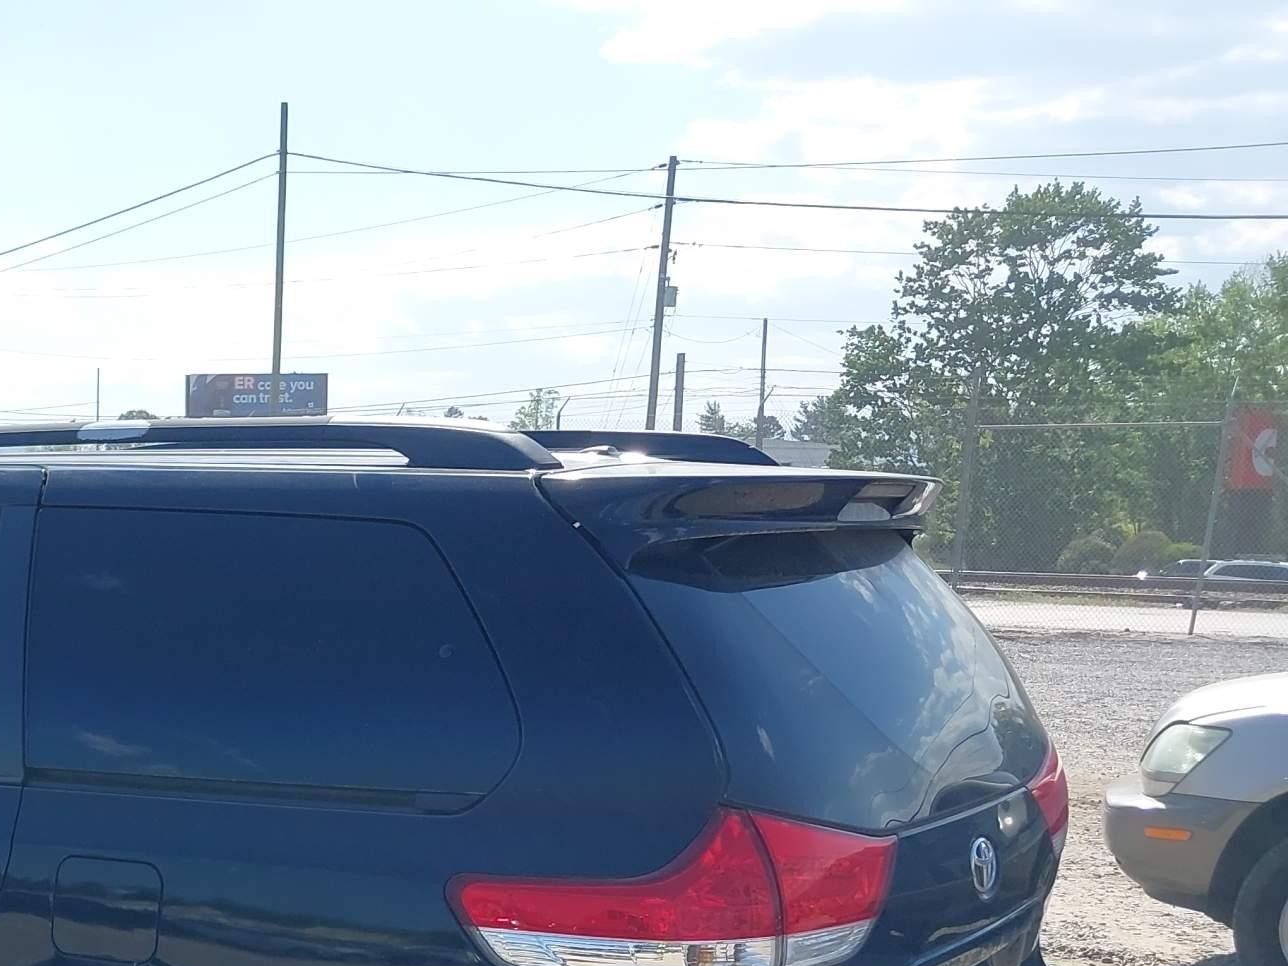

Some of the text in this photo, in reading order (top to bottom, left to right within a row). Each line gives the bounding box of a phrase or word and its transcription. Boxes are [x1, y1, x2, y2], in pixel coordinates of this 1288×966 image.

[234, 376, 314, 393] ER cae you
[233, 392, 293, 403] can trst.
